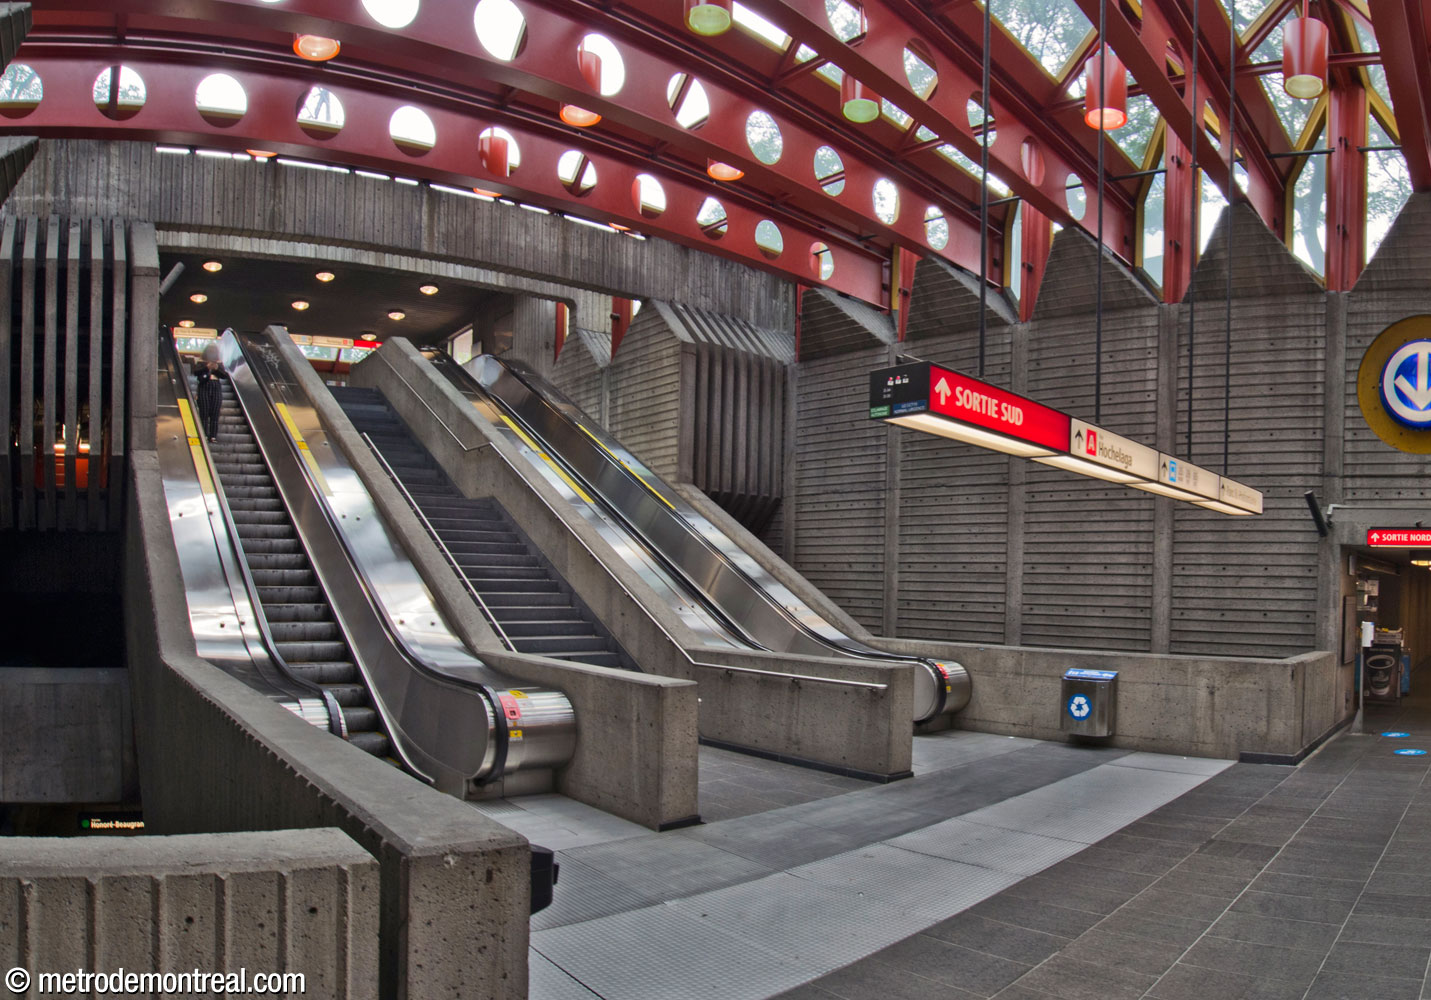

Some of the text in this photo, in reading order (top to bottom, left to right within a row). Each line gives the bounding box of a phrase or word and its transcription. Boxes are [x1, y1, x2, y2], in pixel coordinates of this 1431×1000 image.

[955, 386, 999, 418] SORTIE
[1000, 402, 1023, 426] SUD
[1098, 441, 1133, 469] Hochelaga
[1382, 533, 1431, 542] SORTIE NORD
[91, 820, 145, 829] Honoré-Beaugran
